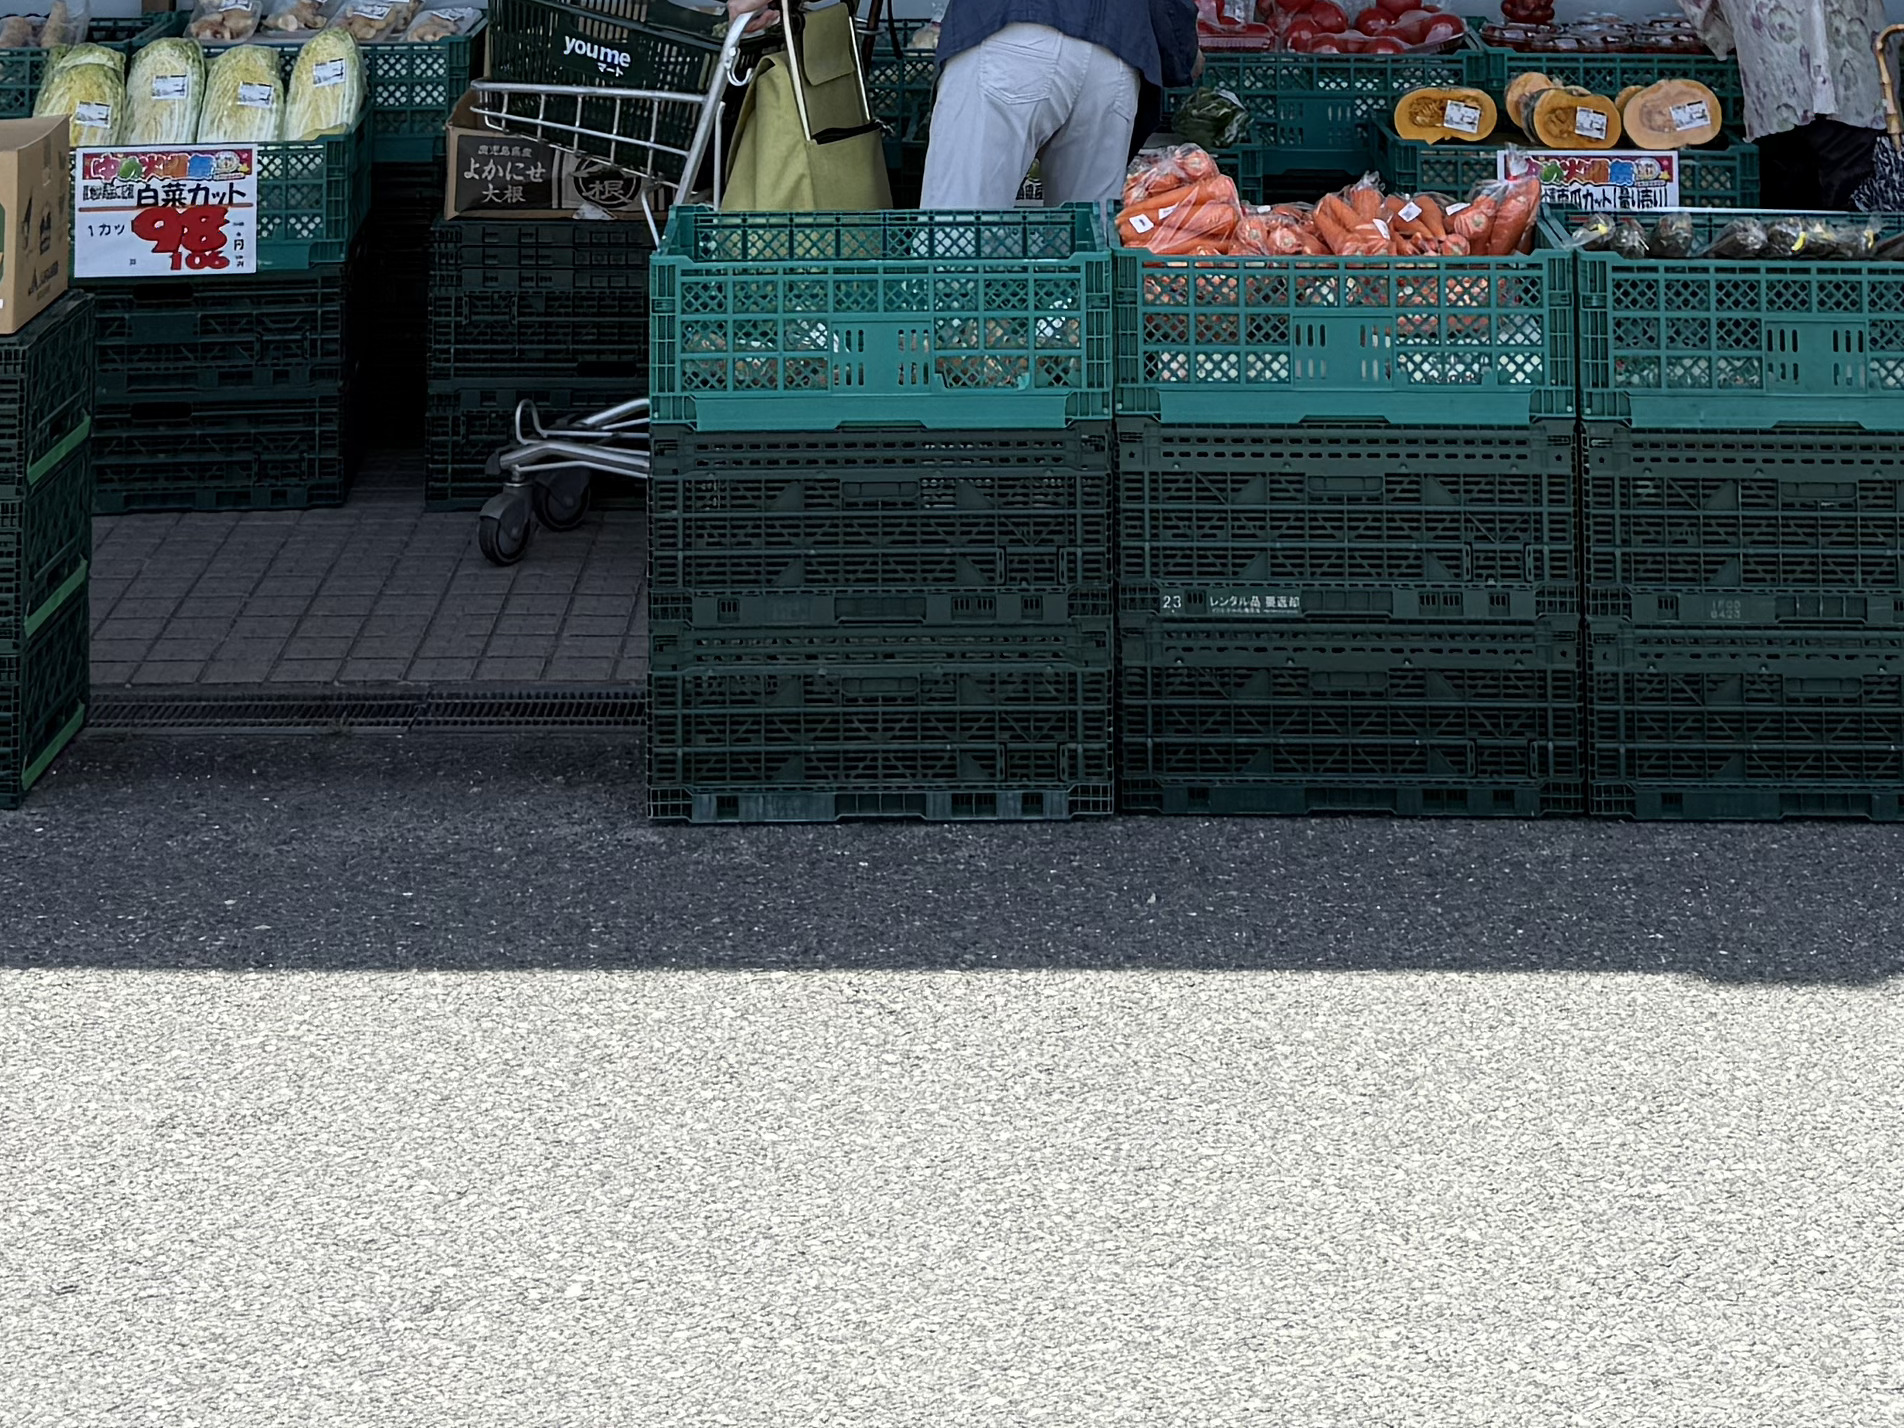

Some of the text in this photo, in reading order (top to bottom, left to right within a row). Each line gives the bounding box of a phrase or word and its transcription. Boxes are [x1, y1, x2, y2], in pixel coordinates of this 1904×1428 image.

[598, 62, 624, 78] マート
[463, 157, 547, 184] よかにせ
[136, 182, 246, 207] 白菜カット
[482, 183, 526, 203] 大根
[131, 206, 230, 253] 98
[170, 250, 230, 270] 106
[1162, 595, 1182, 609] 23
[1209, 595, 1261, 609] レンタル品
